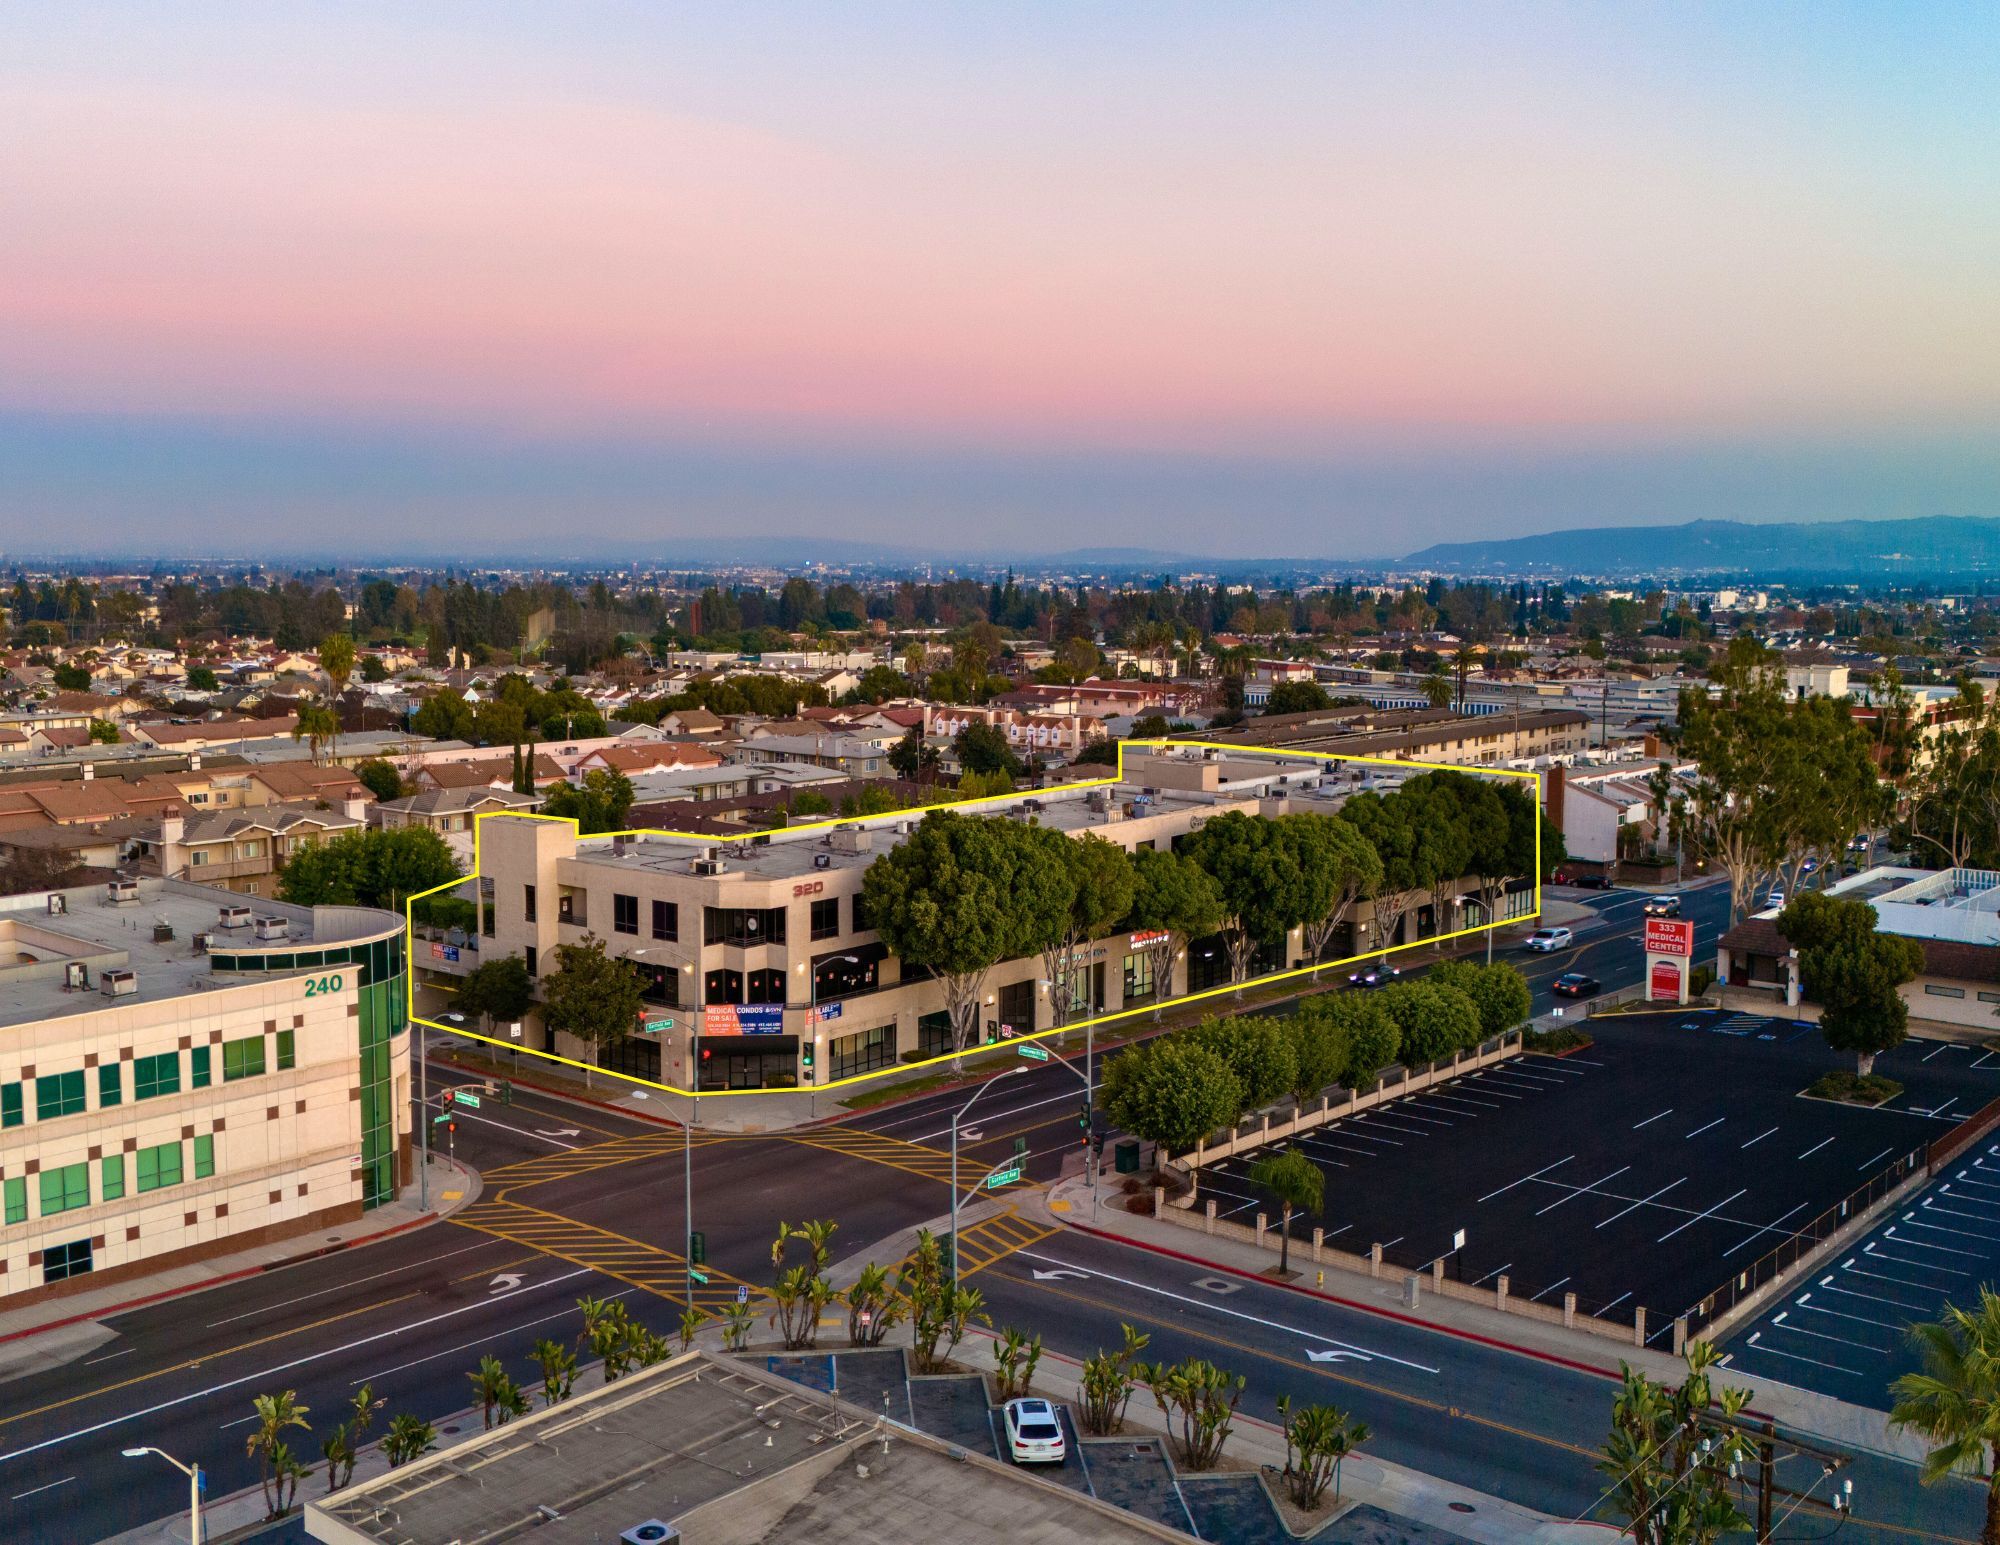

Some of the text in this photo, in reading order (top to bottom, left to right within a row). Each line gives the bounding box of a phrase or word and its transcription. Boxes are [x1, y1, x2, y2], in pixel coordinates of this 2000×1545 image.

[793, 881, 824, 897] 320
[1658, 923, 1676, 932] 333
[1648, 932, 1685, 943] MEDICAL
[1649, 941, 1683, 952] CENTER
[305, 974, 342, 997] 240
